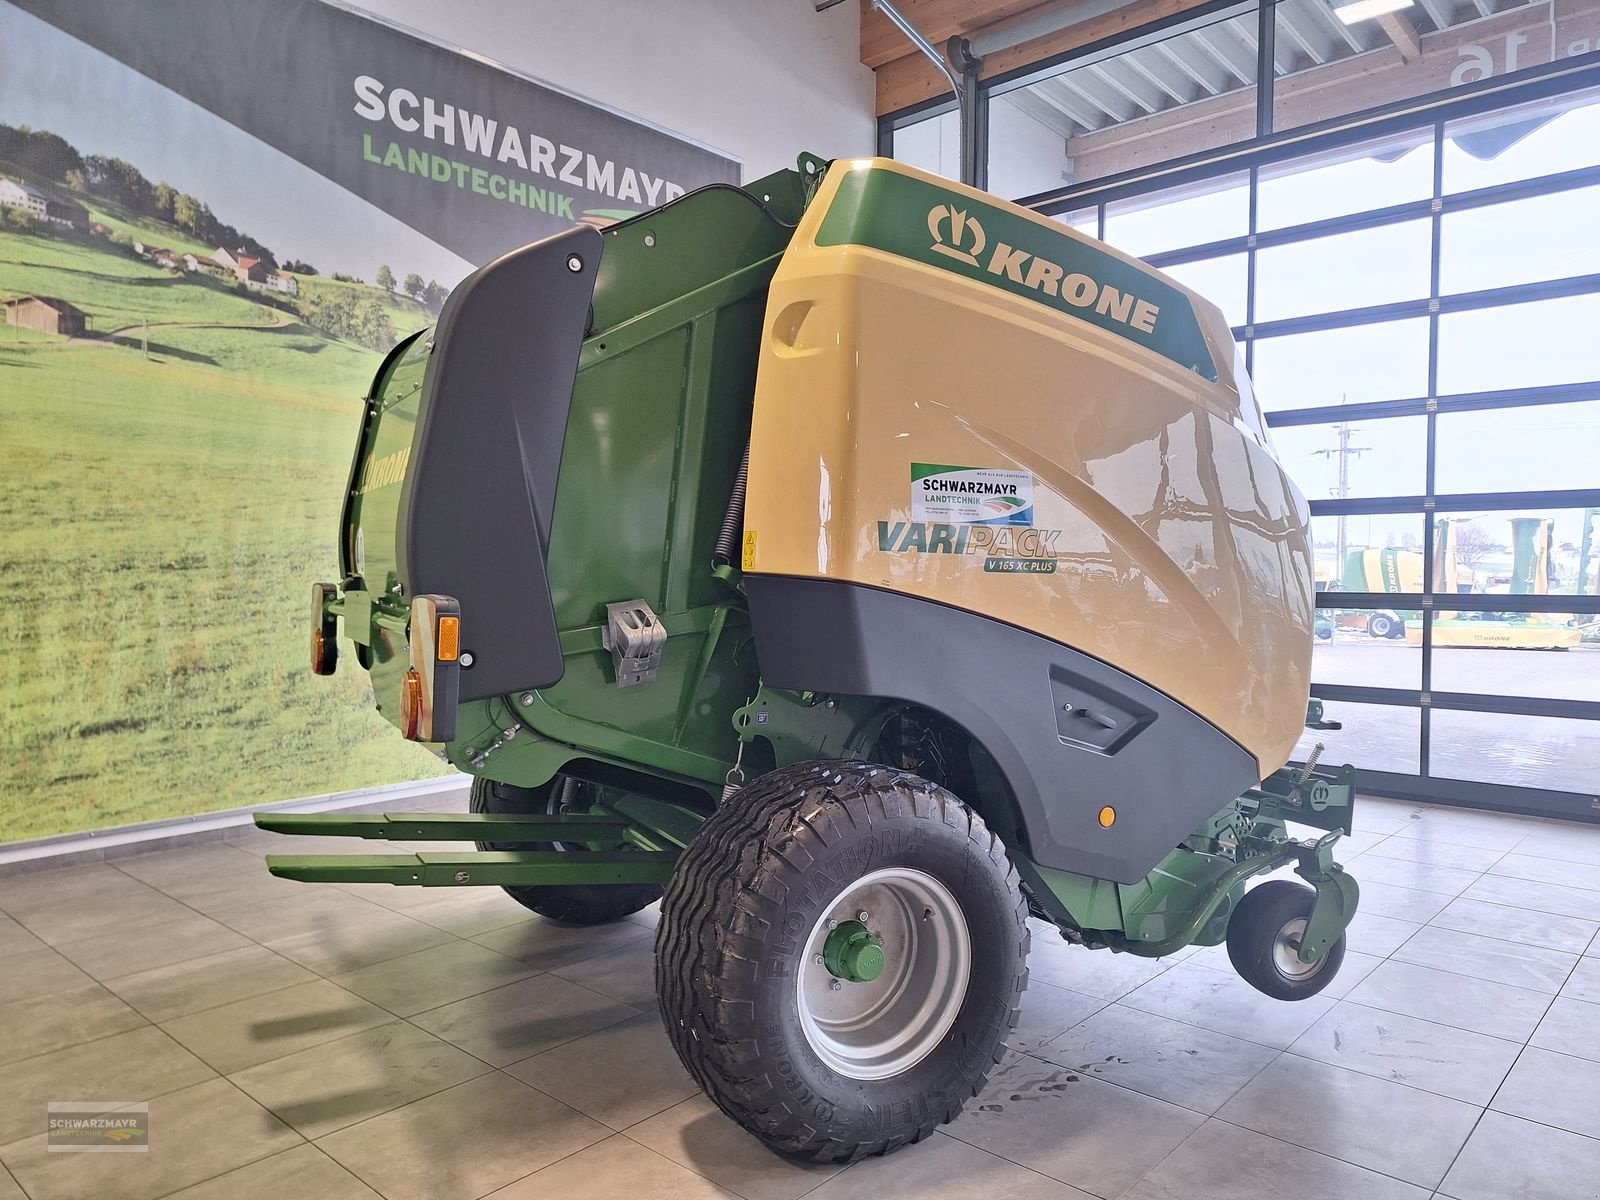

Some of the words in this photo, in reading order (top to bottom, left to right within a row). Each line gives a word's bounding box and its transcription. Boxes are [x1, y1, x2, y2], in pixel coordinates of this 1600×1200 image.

[363, 132, 575, 220] LANDTECHNIK
[986, 241, 1160, 335] KRONE
[923, 479, 1017, 495] SCHWARZMAYR
[925, 495, 981, 505] LANDTECHNIK
[877, 521, 1062, 558] VARIPACK
[989, 561, 995, 570] V
[999, 561, 1014, 570] 165
[1016, 562, 1029, 570] XC
[1030, 562, 1053, 571] PLUS
